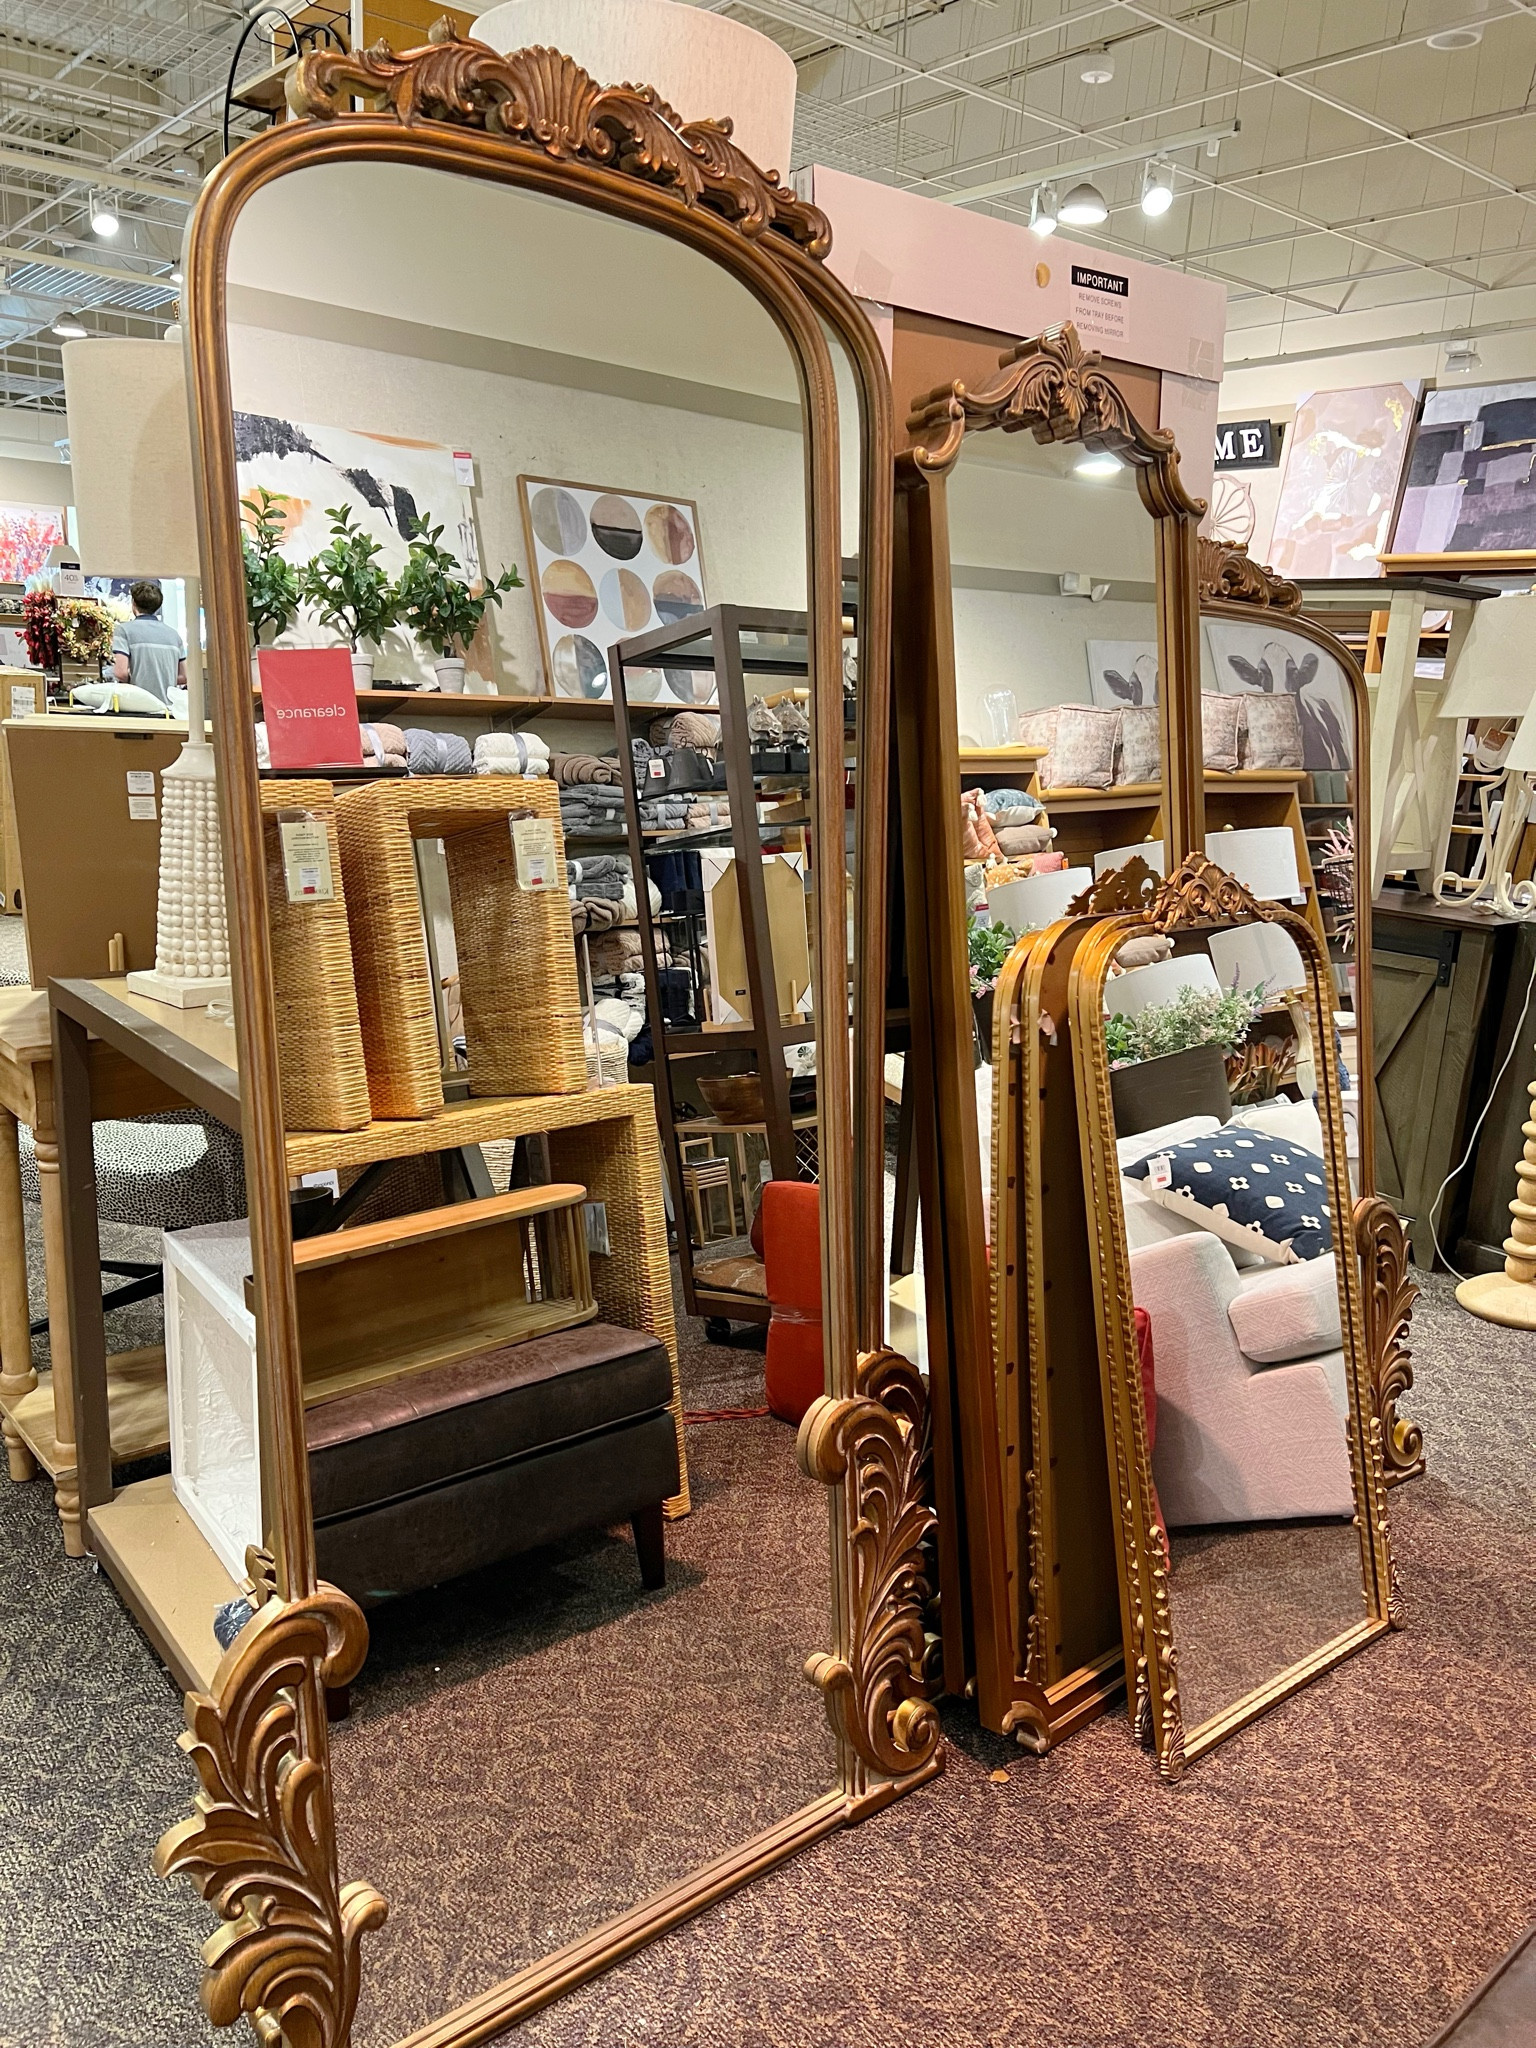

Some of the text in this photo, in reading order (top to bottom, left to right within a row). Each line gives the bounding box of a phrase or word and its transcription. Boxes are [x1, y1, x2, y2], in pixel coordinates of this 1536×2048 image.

[1077, 272, 1123, 292] IMPORTANT
[1079, 293, 1121, 308] REMOVE SCREWS
[1076, 307, 1123, 324] FROM TRAY BEFORE
[1077, 322, 1123, 337] REMOVING MIRROR
